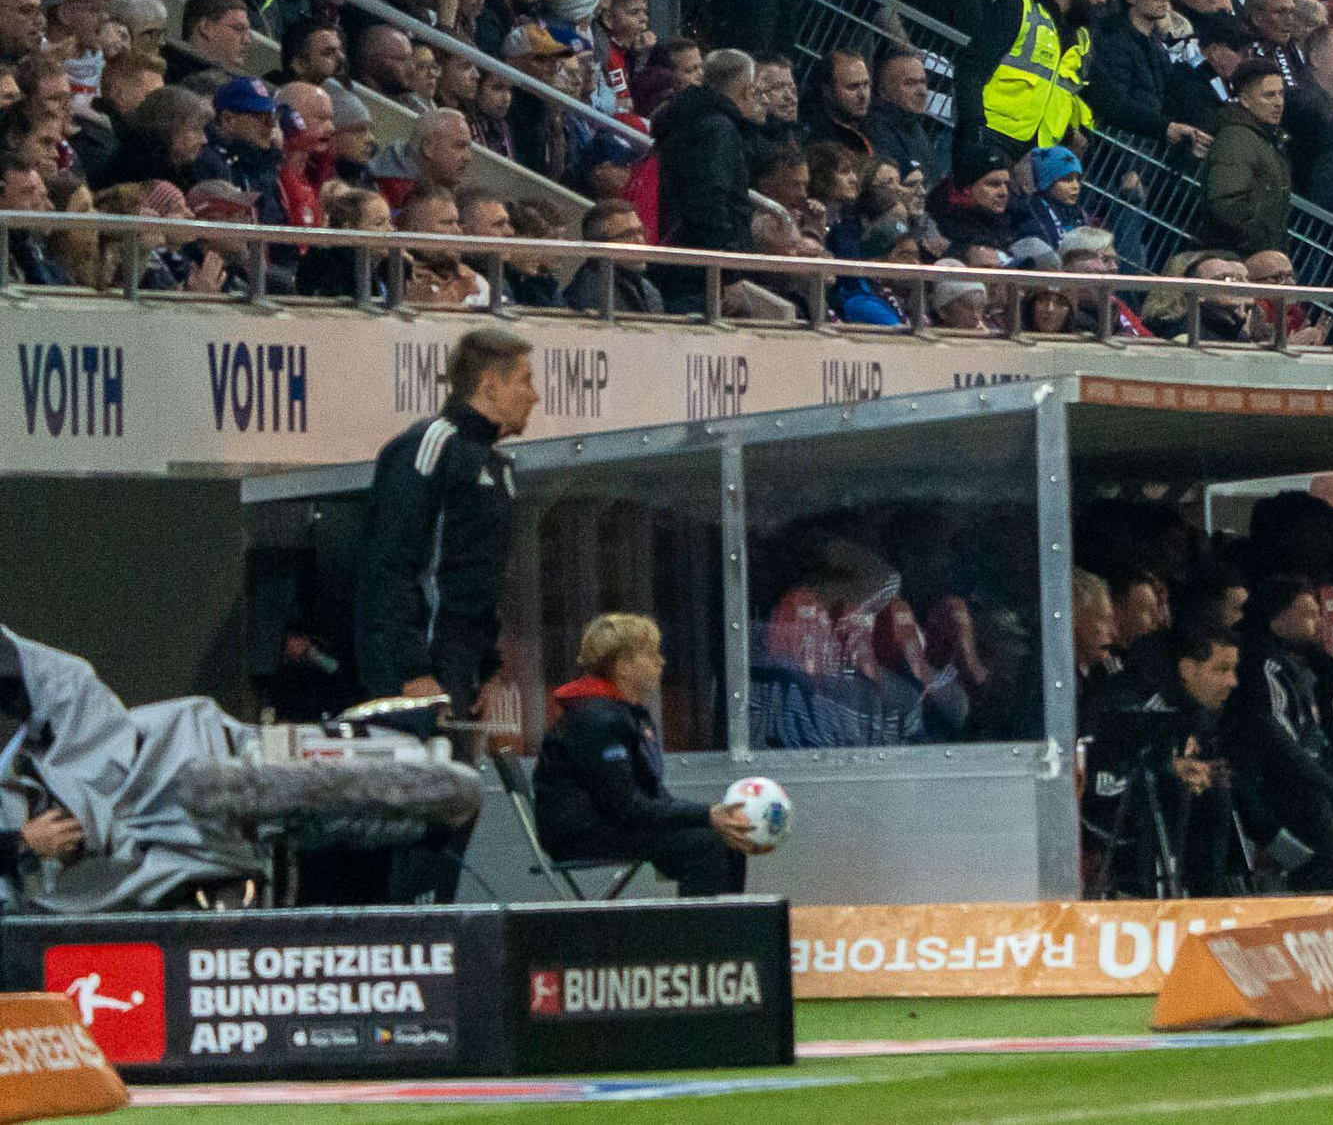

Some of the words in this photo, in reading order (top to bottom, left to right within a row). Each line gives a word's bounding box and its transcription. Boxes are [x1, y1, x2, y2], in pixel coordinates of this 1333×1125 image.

[19, 343, 124, 437] VOITH
[208, 341, 307, 433] VOITH
[189, 948, 250, 980] DIE
[254, 943, 455, 979] OFFIZIELLE
[792, 934, 1075, 973] RAFFSTORE
[189, 981, 425, 1017] BUNDESLIGA
[564, 961, 761, 1013] BUNDESLIGA
[189, 1021, 268, 1055] APP
